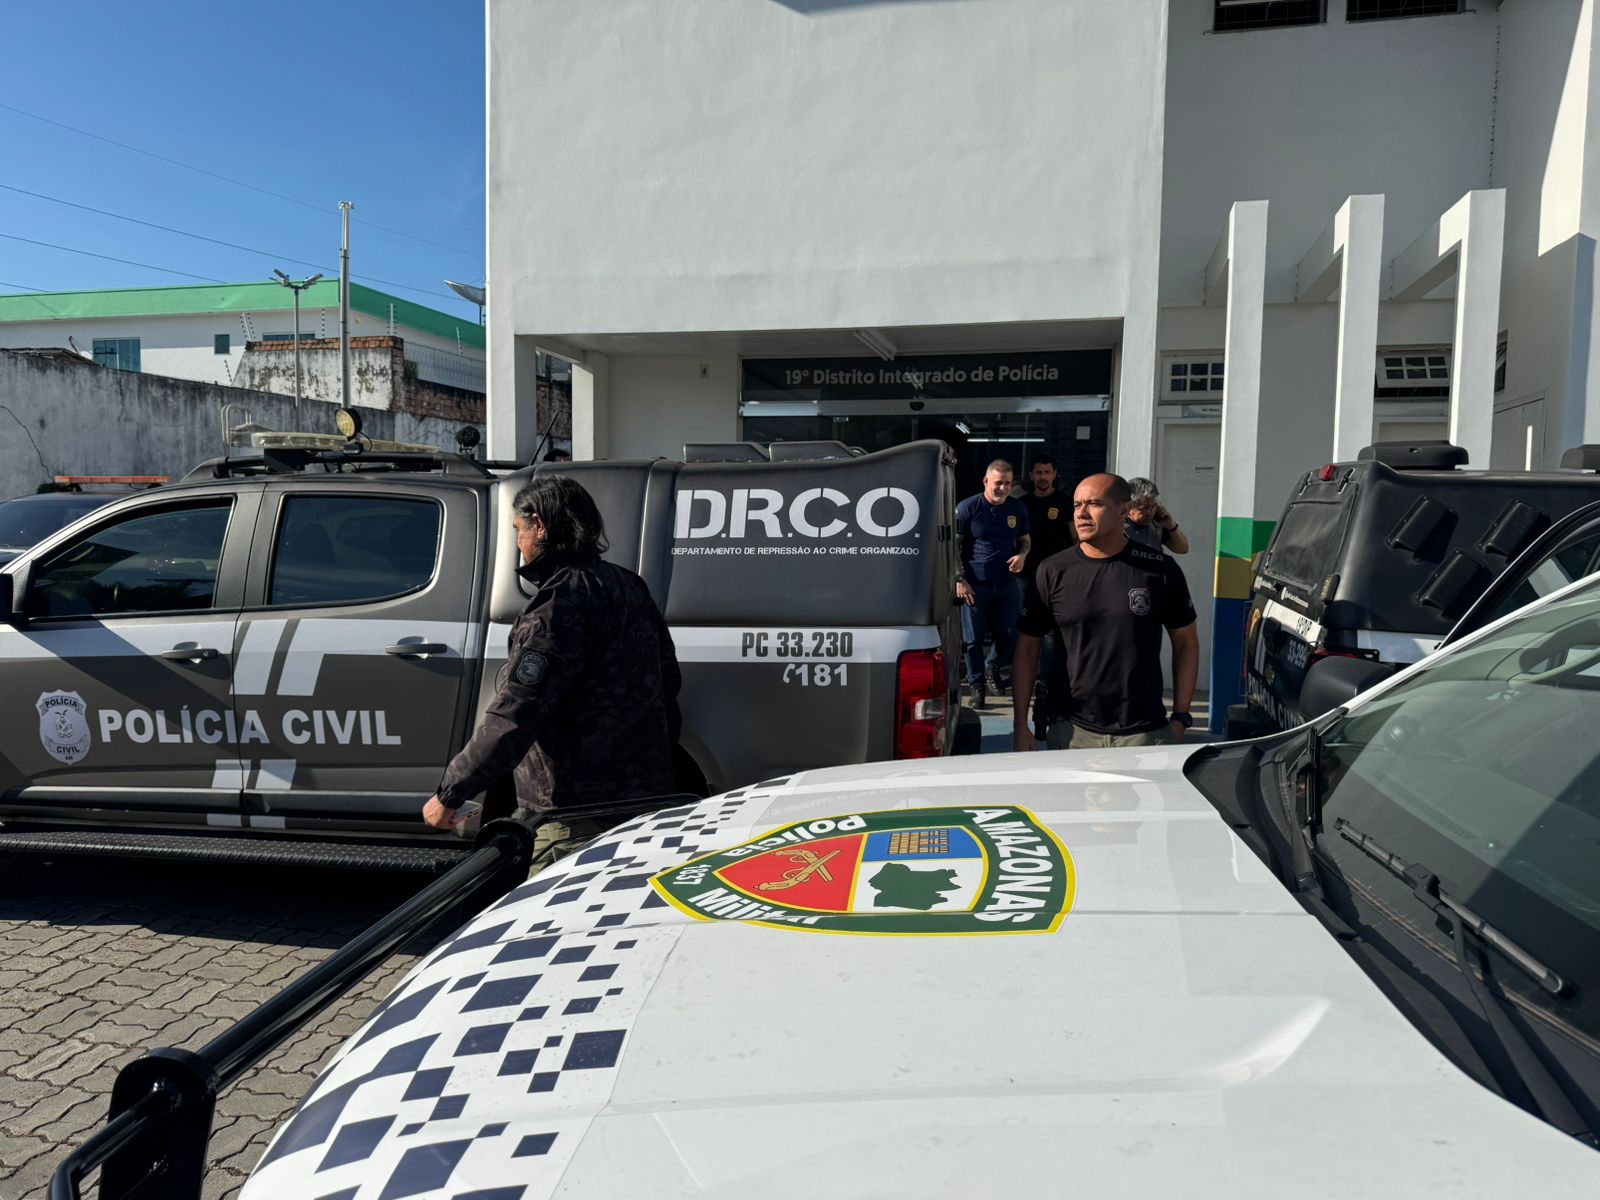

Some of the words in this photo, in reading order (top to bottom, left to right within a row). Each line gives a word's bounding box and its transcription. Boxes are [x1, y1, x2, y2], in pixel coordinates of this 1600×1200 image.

[813, 368, 875, 384] Distrito
[879, 368, 967, 387] Integrado
[970, 366, 994, 382] de
[998, 364, 1059, 381] Polícia
[671, 547, 742, 555] DEPARTAMENTO
[744, 547, 756, 555] DE
[757, 545, 811, 555] REPRESSÃO
[812, 546, 827, 555] AO
[829, 546, 858, 555] CRIME
[860, 547, 920, 555] ORGANIZADO
[741, 631, 769, 658] PC
[776, 631, 854, 658] 33.230
[795, 663, 848, 687] 181
[44, 697, 78, 708] POLÍCIA
[98, 704, 271, 744] POLÍCIA
[281, 709, 402, 745] CIVIL
[56, 745, 81, 754] CIVIL
[720, 814, 867, 859] Polícia
[672, 863, 712, 886] 1837
[962, 808, 1054, 923] AMAZONAS
